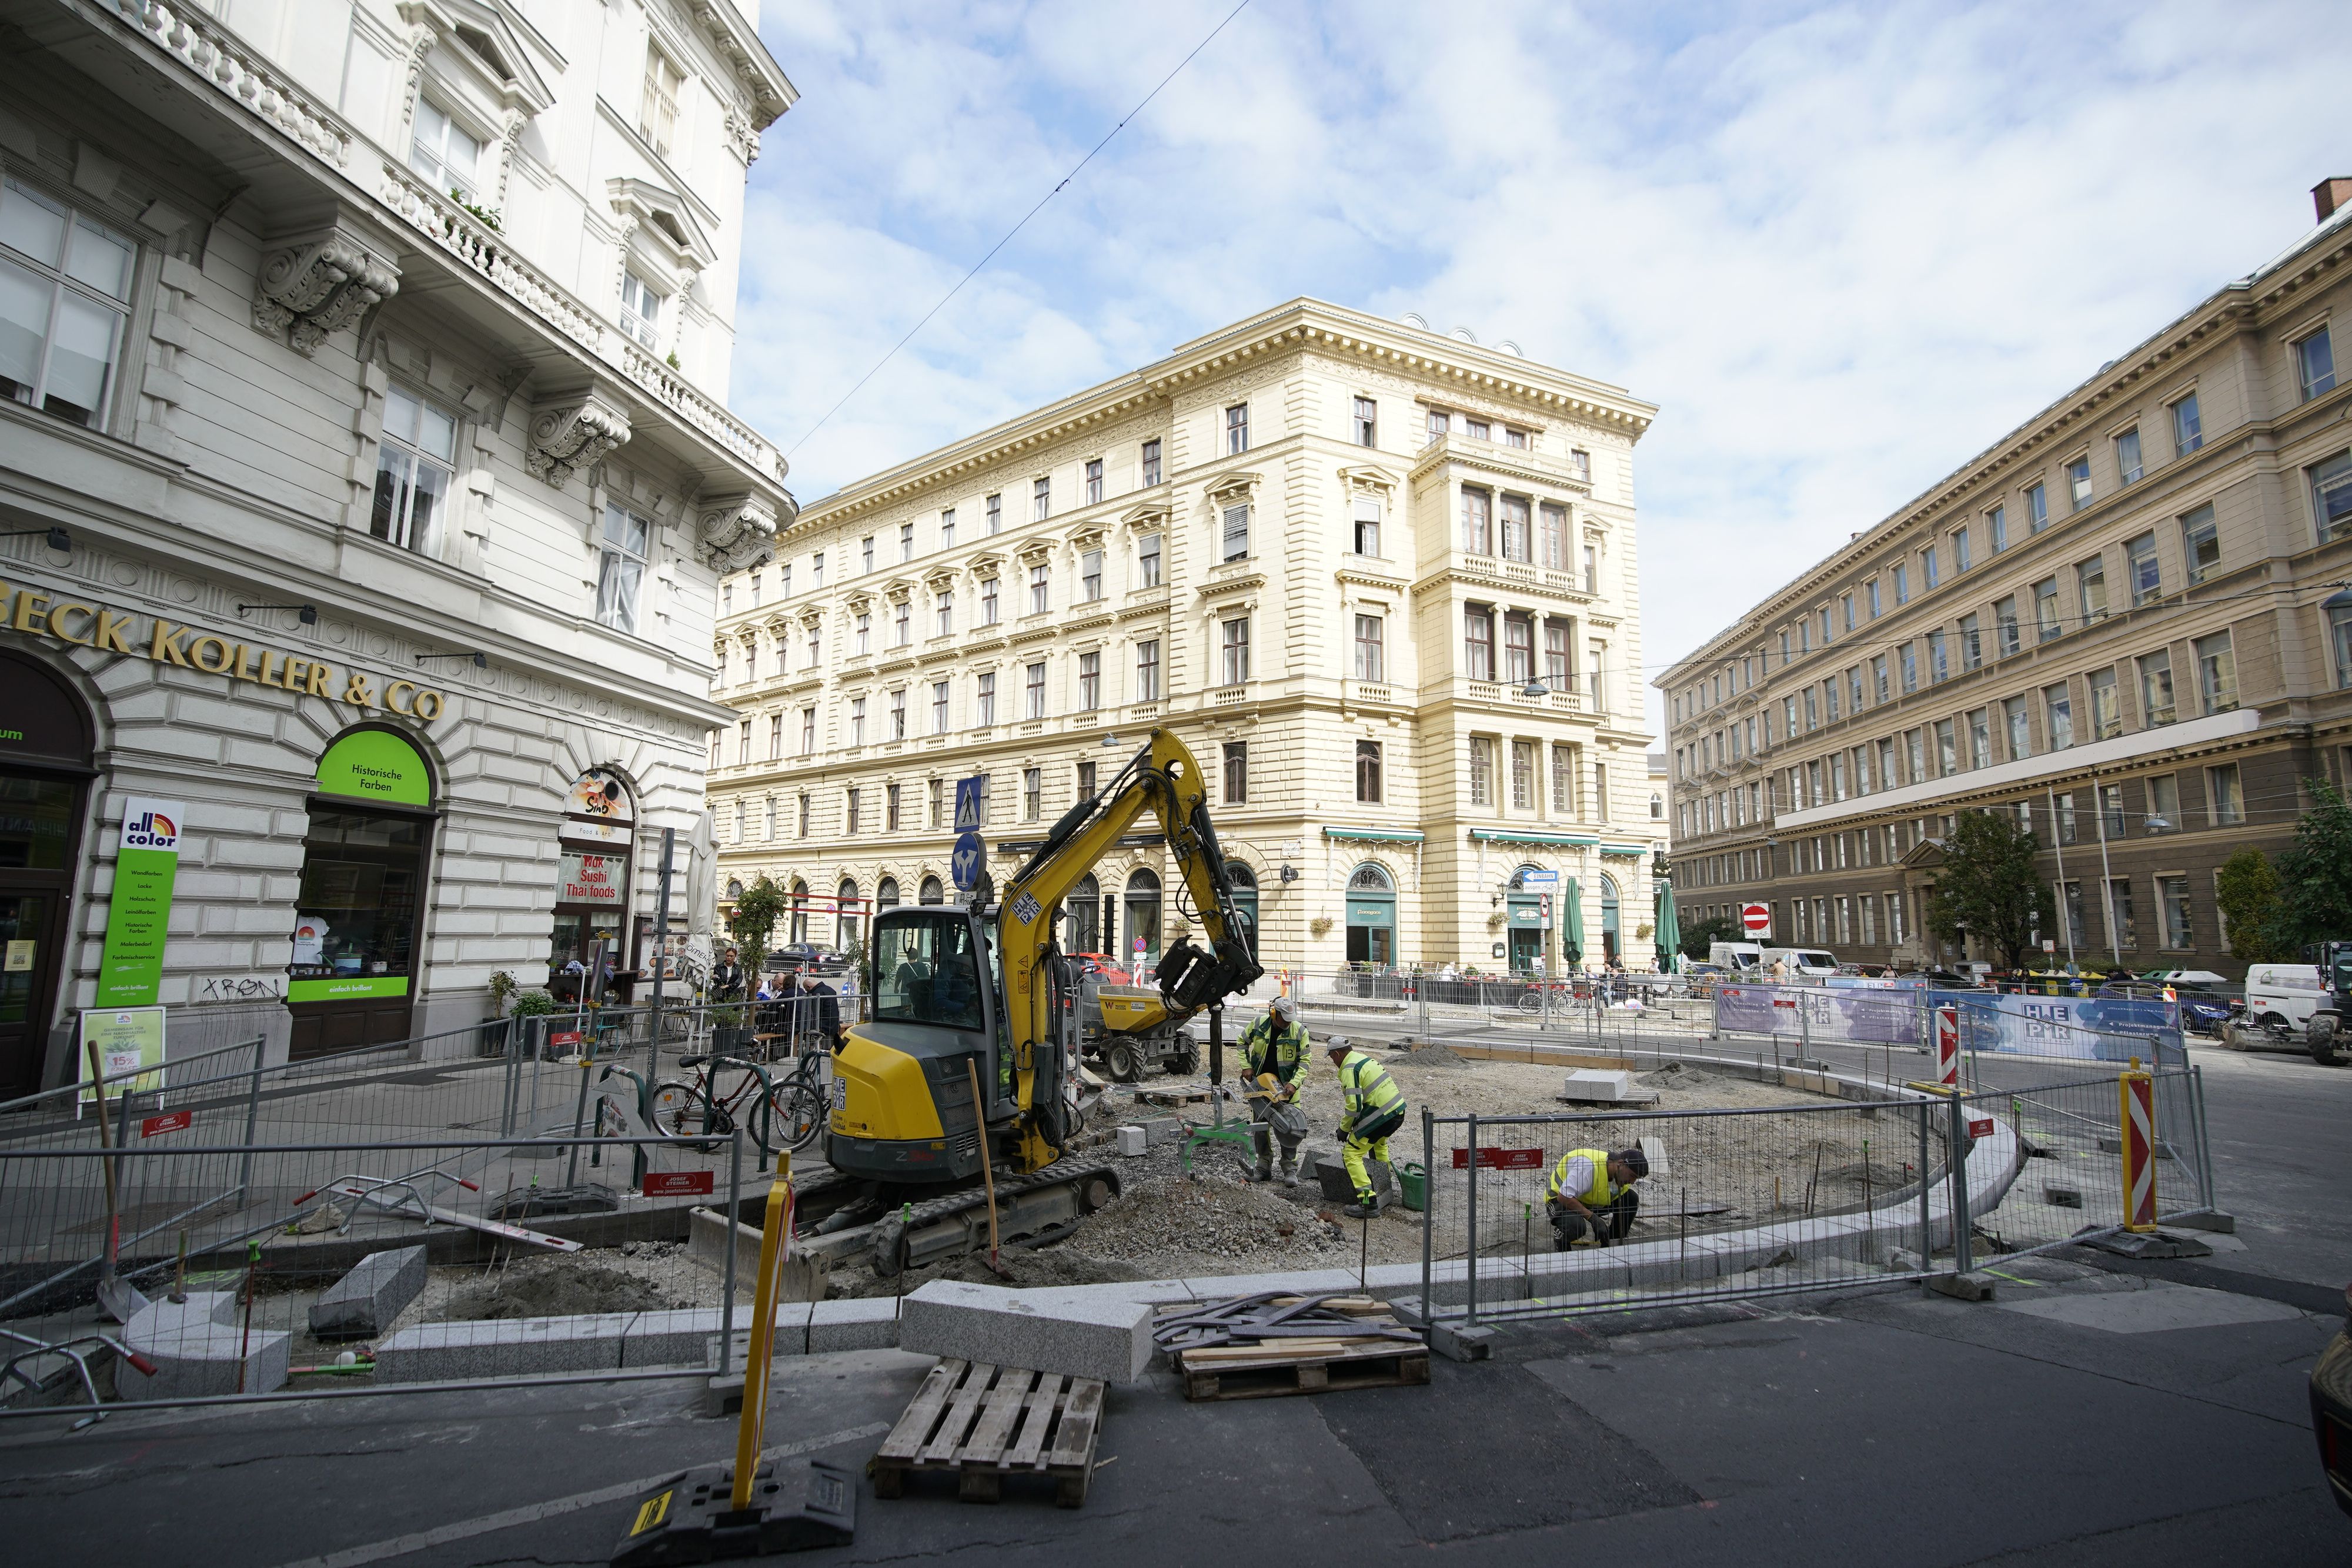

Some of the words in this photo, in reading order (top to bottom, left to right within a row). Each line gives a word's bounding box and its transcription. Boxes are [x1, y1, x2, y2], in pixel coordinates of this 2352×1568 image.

[151, 619, 333, 698] KOLLER
[345, 674, 374, 707] &
[385, 680, 445, 721] CO
[352, 764, 402, 780] Historische
[360, 779, 392, 792] Farben
[128, 813, 154, 833] all
[127, 833, 176, 847] color
[583, 854, 604, 868] Wok
[580, 869, 607, 882] Sushi
[566, 883, 587, 897] Thai
[590, 884, 615, 898] foods
[112, 1057, 135, 1066] 15%
